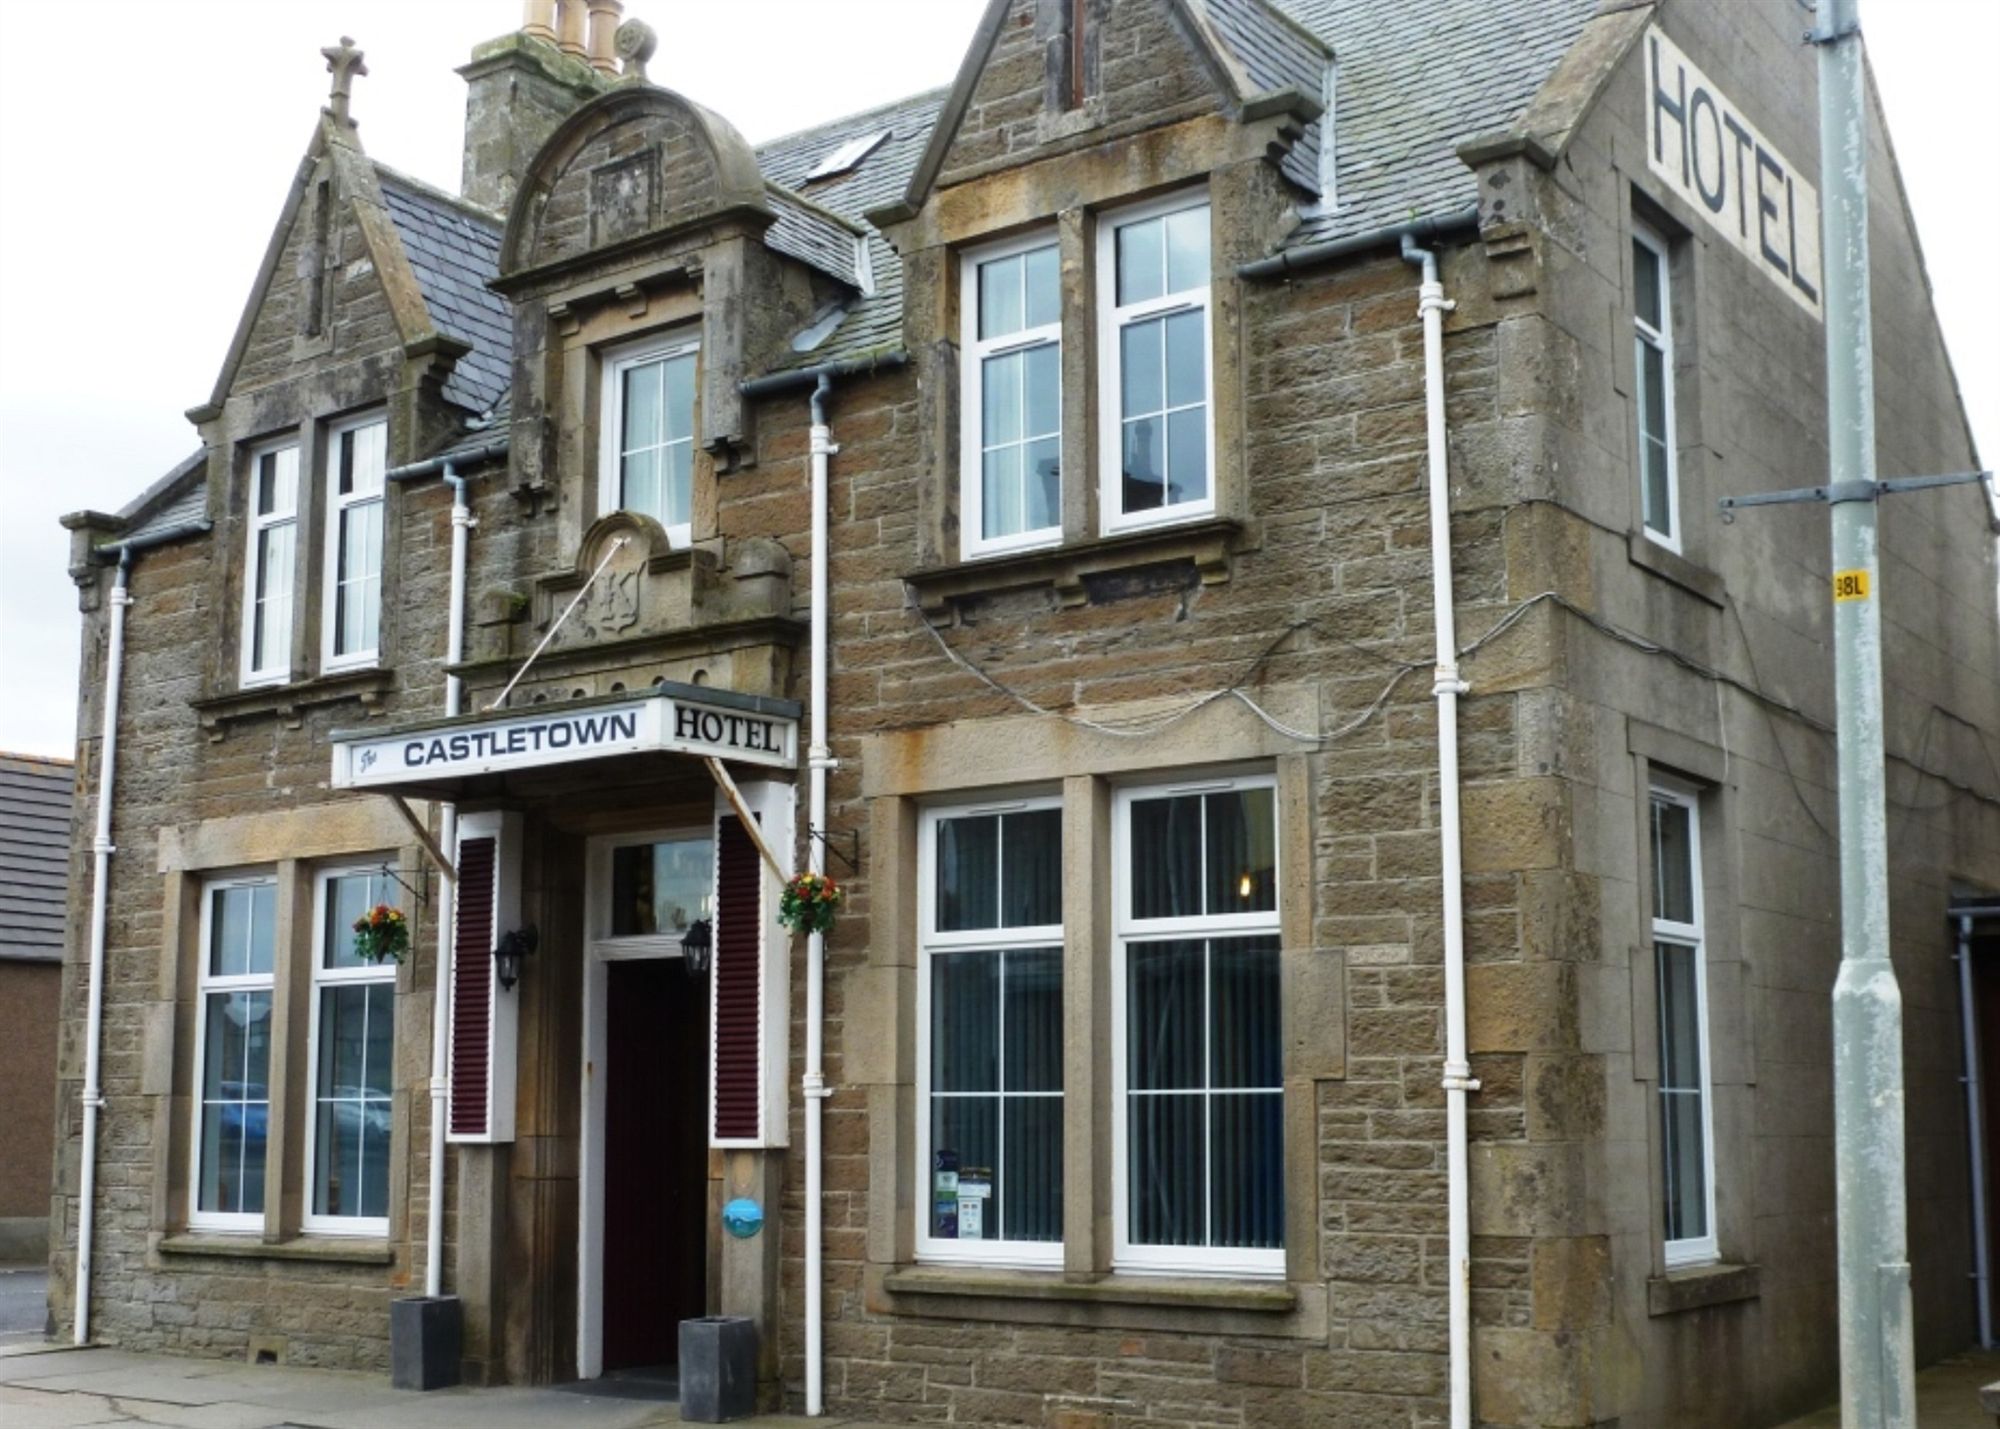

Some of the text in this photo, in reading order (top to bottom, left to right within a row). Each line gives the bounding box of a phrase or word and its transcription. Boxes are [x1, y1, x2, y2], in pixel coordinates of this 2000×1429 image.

[1650, 34, 1818, 306] HOTEL
[403, 712, 636, 767] CASTLETOWN
[674, 705, 781, 753] HOTEL
